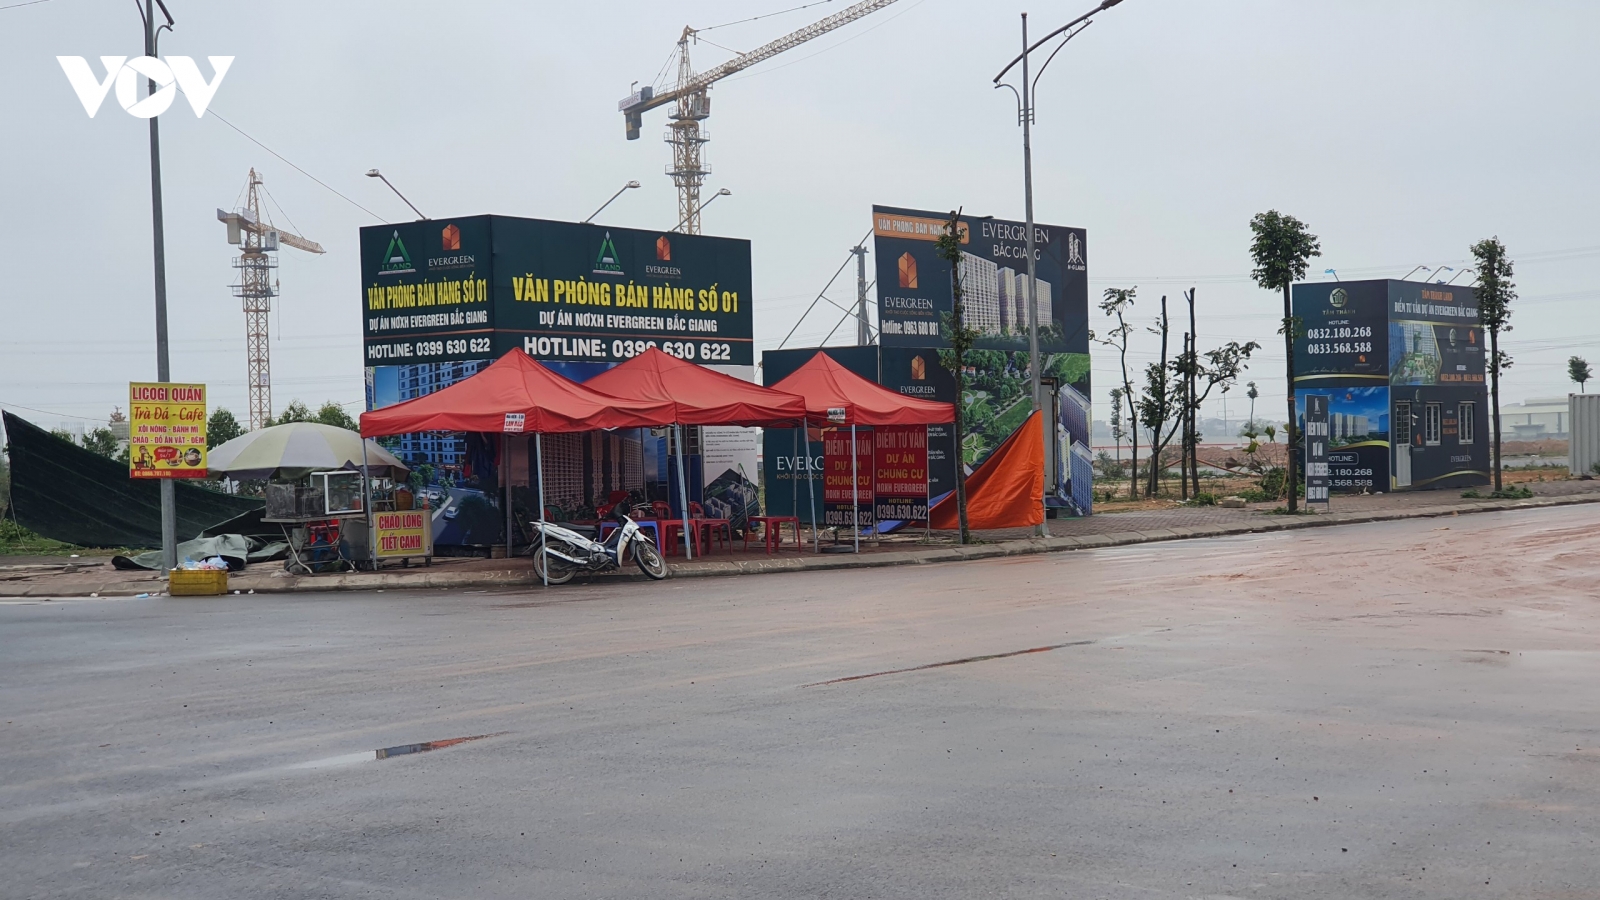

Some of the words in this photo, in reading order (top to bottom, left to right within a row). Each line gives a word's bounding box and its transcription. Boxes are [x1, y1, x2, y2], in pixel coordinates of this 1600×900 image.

[893, 219, 913, 232] PHÒNG
[982, 222, 1049, 243] EVERGREN
[993, 240, 1011, 257] BẮC
[1013, 246, 1040, 260] GIAG
[428, 255, 474, 266] EVERGREEN
[646, 266, 681, 275] EVERGREEN
[368, 283, 384, 310] VĂN
[387, 280, 416, 308] PHÒNG
[418, 278, 435, 306] BÁN
[437, 277, 460, 305] HÀNG
[463, 271, 475, 303] SỐ
[477, 279, 487, 302] 01
[512, 273, 548, 302] VĂN
[554, 276, 610, 306] PHÒNG
[615, 280, 648, 308] BÁN
[653, 282, 694, 311] HÀNG
[698, 283, 718, 312] SỐ
[722, 292, 738, 313] 01
[884, 297, 933, 309] EVERGREEN
[1435, 305, 1457, 316] EVERGREEN
[369, 317, 379, 333] DỰ
[380, 316, 389, 330] ÁN
[410, 313, 449, 328] EVERGREEN
[450, 308, 464, 325] BẮC
[466, 310, 487, 324] GIANG
[539, 311, 555, 328] DỰ
[557, 309, 572, 325] ÁN
[575, 312, 604, 328] NƠXH
[607, 314, 664, 330] EVERGREEN
[666, 313, 686, 331] BẮC
[688, 318, 718, 332] GIANG
[882, 320, 903, 334] Hotline:
[904, 321, 917, 335] 0963
[1308, 326, 1372, 339] 0832.180.268
[368, 343, 413, 358] HOTLINE:
[416, 341, 443, 356] 0399
[446, 340, 466, 354] 630
[470, 338, 490, 352] 622
[523, 337, 606, 357] HOTLINE:
[663, 341, 695, 359] 630
[700, 343, 731, 360] 622
[1308, 342, 1372, 354] 0833.568.588
[132, 387, 168, 400] LICOGI
[900, 386, 936, 394] EVERGREEN
[134, 407, 150, 420] Trà
[154, 407, 169, 420] Đá
[180, 407, 204, 422] Cafe
[150, 425, 167, 433] NÓNG
[173, 425, 189, 433] BÁNH
[133, 435, 148, 443] CHÁO
[826, 434, 844, 455] ĐIỂM
[856, 434, 871, 455] VẤN
[876, 427, 896, 448] ĐIỂM
[898, 431, 908, 448] TƯ
[909, 427, 925, 448] VẤN
[886, 454, 899, 466] DỰ
[902, 452, 915, 463] ÁN
[834, 461, 846, 473] DỰ
[878, 469, 908, 478] CHUNG
[911, 469, 924, 479] CƯ
[826, 476, 854, 485] CHUNG
[858, 476, 870, 485] CƯ
[894, 483, 926, 493] EVERGREEN
[877, 505, 926, 519] 0399.630.622
[379, 514, 400, 529] CHÁO
[402, 513, 421, 528] LÒNG
[381, 532, 397, 549] TIẾT
[400, 535, 420, 548] CANH
